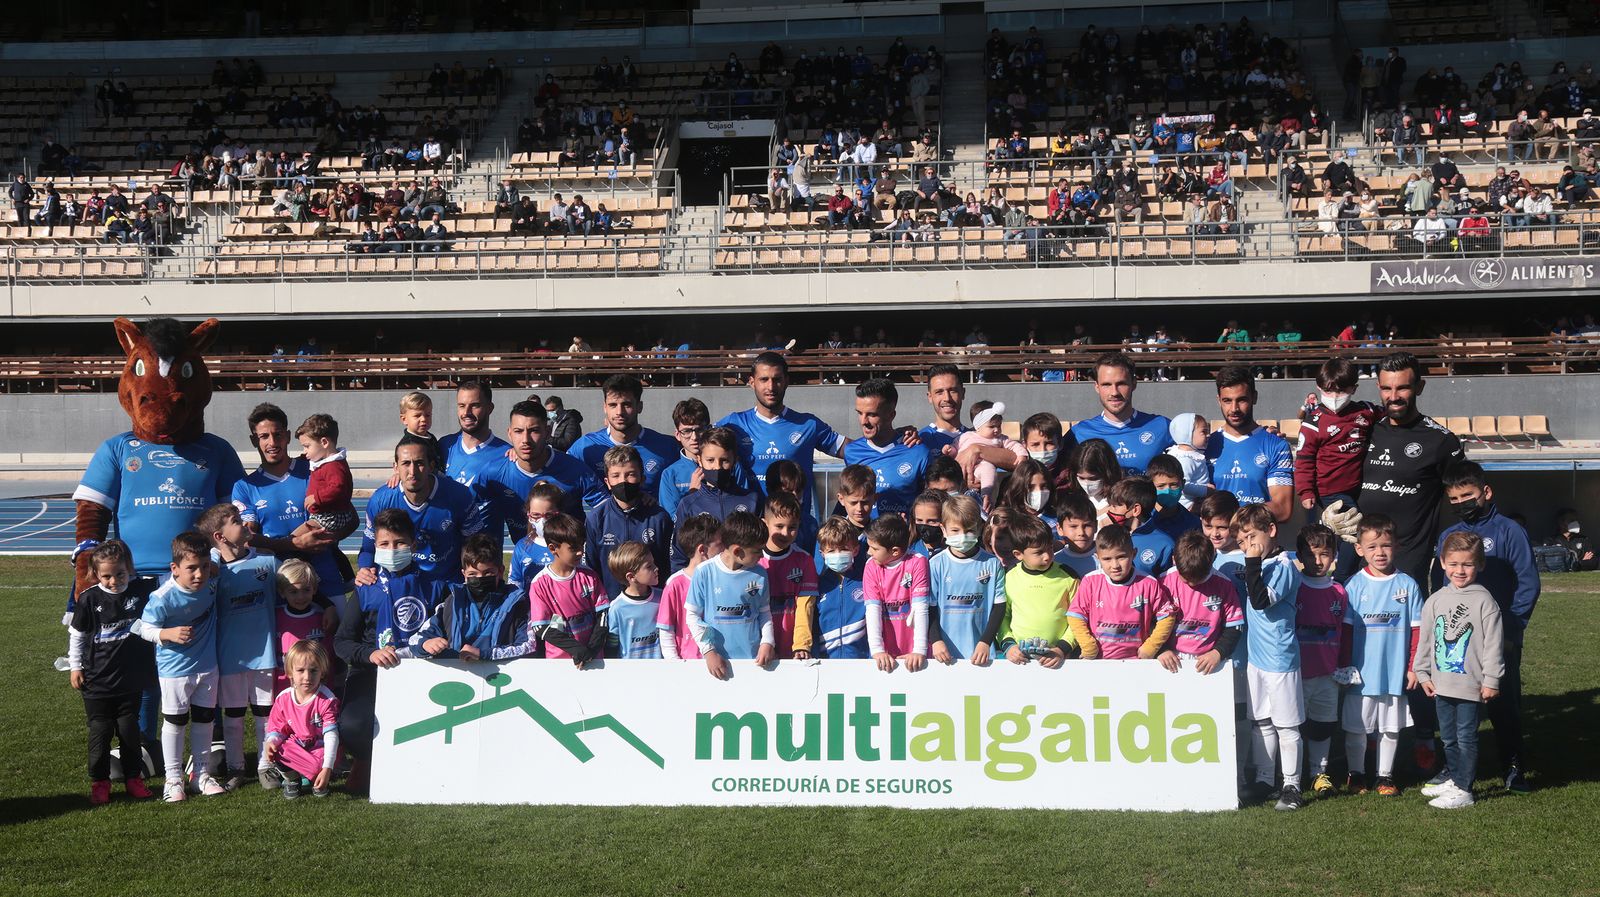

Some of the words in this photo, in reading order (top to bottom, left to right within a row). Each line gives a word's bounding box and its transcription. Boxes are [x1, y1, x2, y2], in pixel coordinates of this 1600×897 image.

[707, 122, 734, 131] Cajasol
[1376, 266, 1464, 287] Andalucía
[1382, 479, 1418, 497] Swipe
[134, 496, 205, 506] PUBLIPONCE
[1235, 490, 1265, 504] Swipe
[1362, 612, 1401, 620] Torralva
[1096, 621, 1140, 630] Torralva
[631, 632, 660, 644] Torral
[694, 692, 1221, 782] multialgaida
[711, 775, 831, 794] CORREDURÍA
[836, 777, 861, 794] DE
[865, 777, 953, 795] SEGUROS
